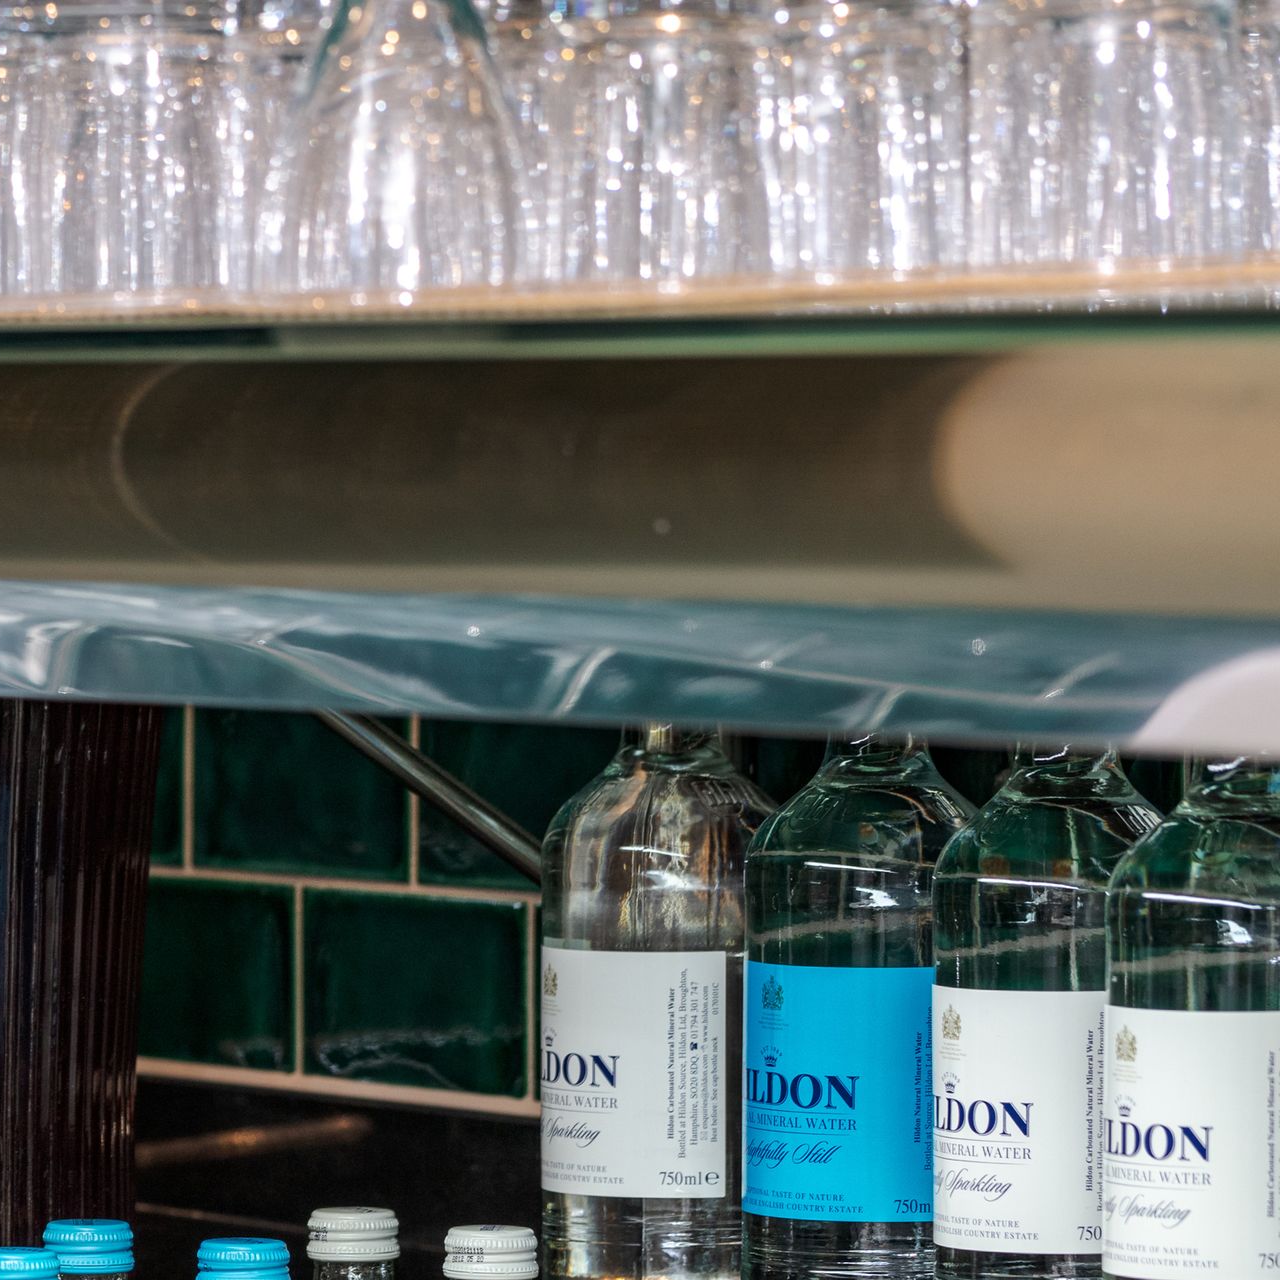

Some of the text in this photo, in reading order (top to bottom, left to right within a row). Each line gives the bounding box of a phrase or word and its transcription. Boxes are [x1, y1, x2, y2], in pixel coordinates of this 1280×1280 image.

[678, 968, 688, 1158] Bottled at Hildon Source, Hildon Ltd, Broughton,
[691, 1056, 699, 1075] 8DQ
[914, 1032, 922, 1143] Hildon Natural Mineral Water
[574, 1095, 618, 1109] WATER
[691, 1102, 699, 1145] Hampshire,
[755, 1112, 801, 1129] MINERAL
[805, 1117, 857, 1131] WATER
[546, 1116, 600, 1149] Sparkling
[792, 1140, 842, 1165] Still
[982, 1146, 1032, 1160] WATER
[577, 1164, 608, 1173] NATURE
[593, 1176, 624, 1185] ESTATE
[945, 1168, 1012, 1203] Sparkling
[1159, 1171, 1212, 1186] WATER
[771, 1190, 792, 1199] TASTE
[809, 1192, 844, 1202] NATURE
[786, 1202, 826, 1213] COUNTRY
[828, 1206, 864, 1214] ESTATE
[1119, 1194, 1191, 1230] Sparkling
[951, 1215, 970, 1226] TASTE
[972, 1218, 981, 1226] OF
[985, 1219, 1020, 1228] NATURE
[964, 1228, 1001, 1240] COUNTRY
[1004, 1231, 1039, 1240] ESTATE
[1077, 1226, 1102, 1241] 750
[1149, 1246, 1160, 1254] OF
[1162, 1247, 1199, 1256] NATURE
[1140, 1257, 1180, 1268] COUNTRY
[1183, 1260, 1219, 1269] ESTATE
